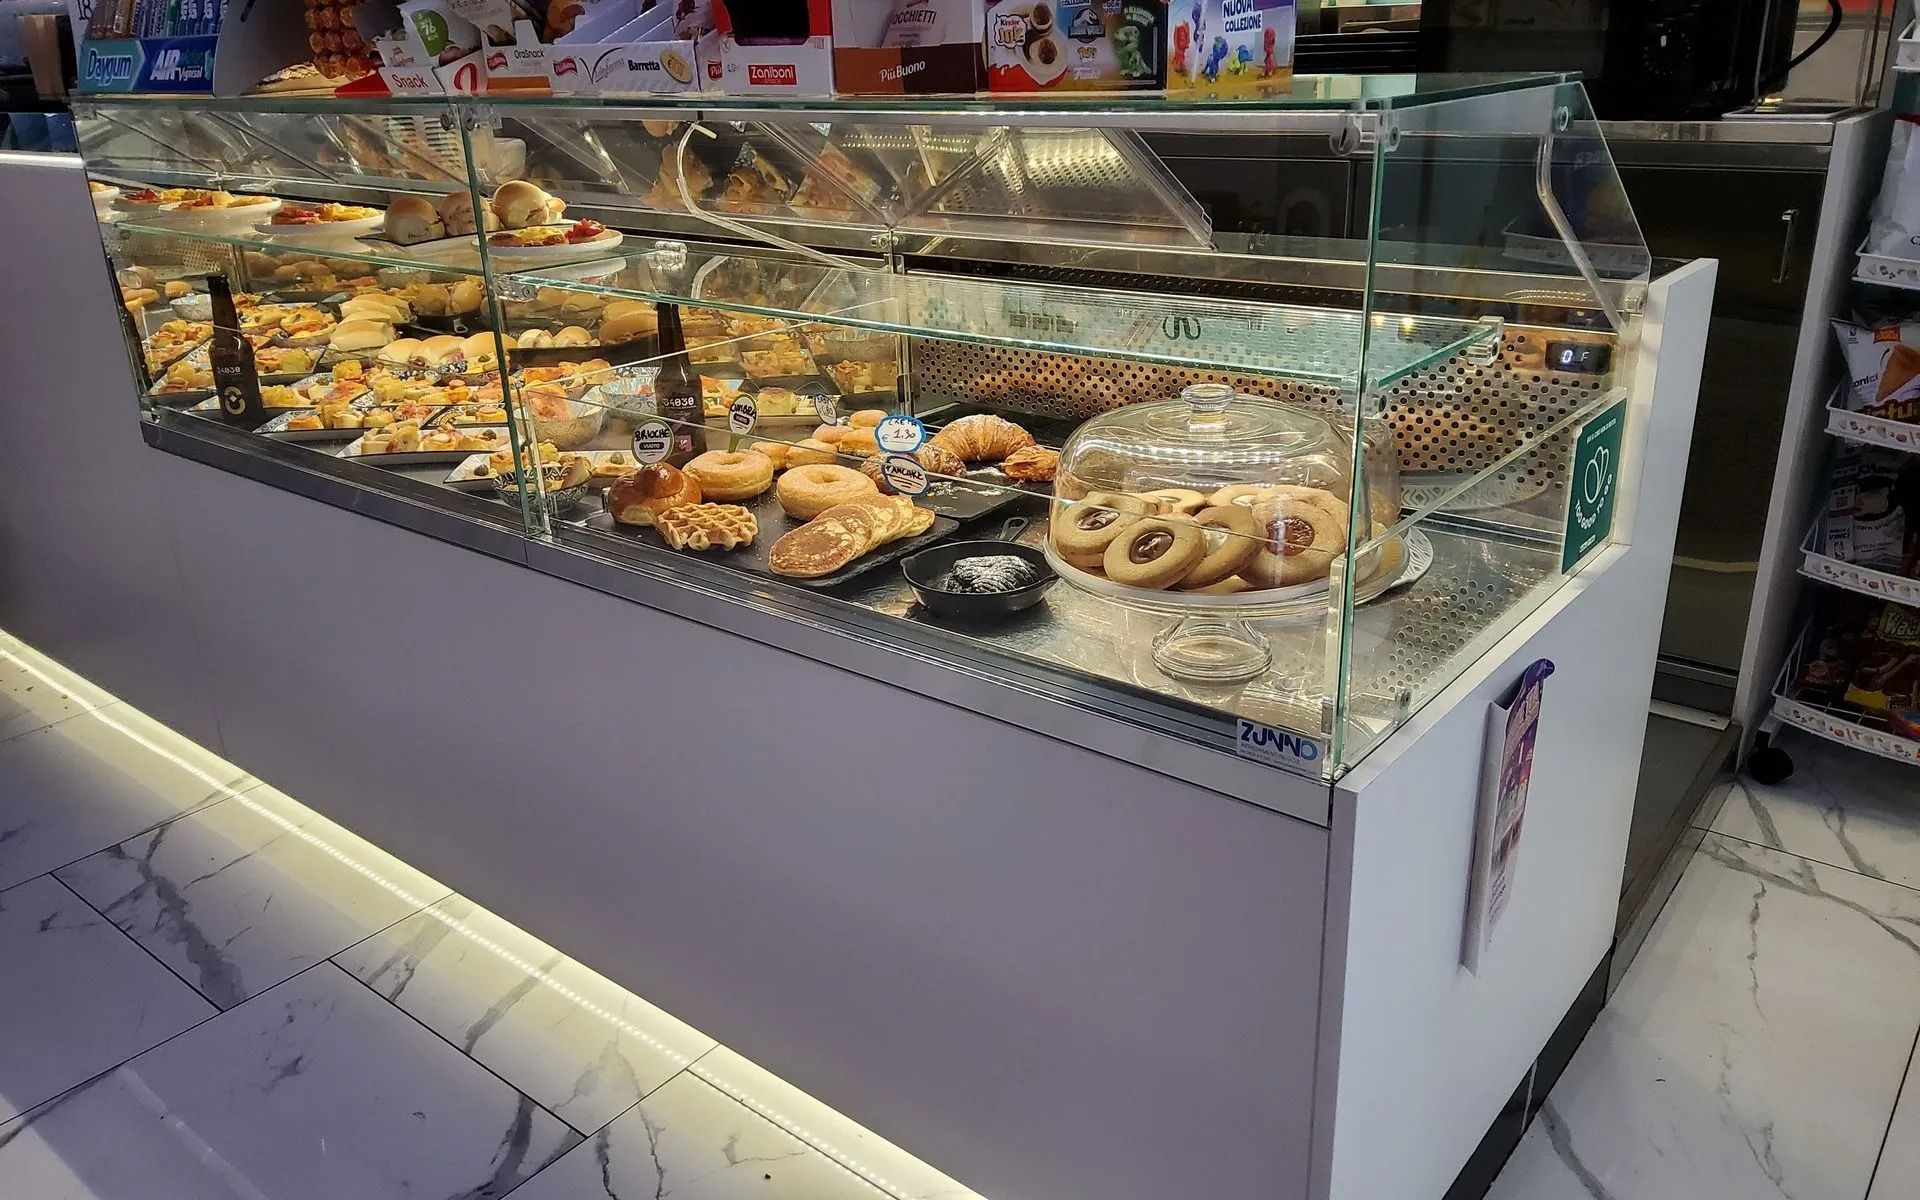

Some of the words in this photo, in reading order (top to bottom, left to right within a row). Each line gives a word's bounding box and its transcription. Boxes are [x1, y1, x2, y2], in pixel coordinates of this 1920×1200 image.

[1223, 0, 1253, 18] NUOVA
[1225, 14, 1261, 32] COLLEZIONE
[514, 49, 545, 59] OraSnack
[85, 48, 132, 87] Daygum
[149, 49, 181, 80] AIR
[628, 60, 660, 71] Barretta
[751, 66, 794, 79] Zaniboni
[392, 74, 428, 88] Snack
[635, 429, 671, 442] BRIOCHE
[1241, 722, 1318, 760] ZUNNO
